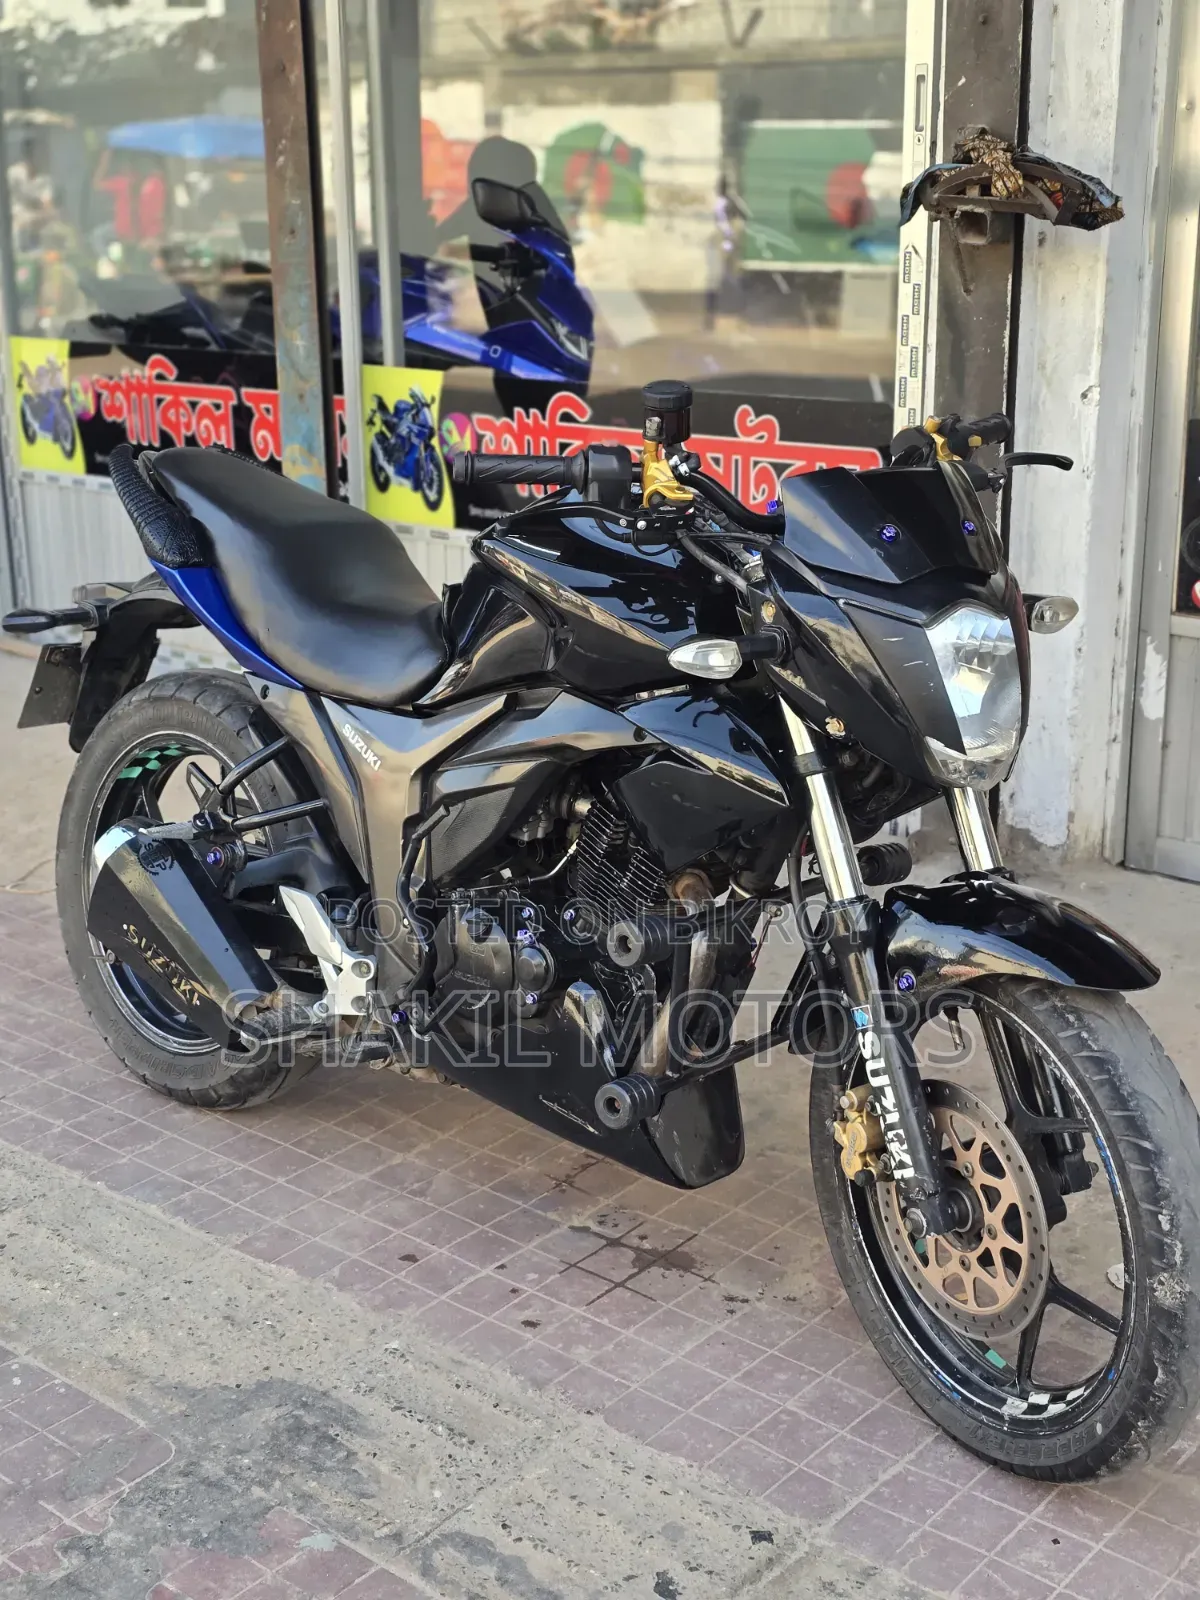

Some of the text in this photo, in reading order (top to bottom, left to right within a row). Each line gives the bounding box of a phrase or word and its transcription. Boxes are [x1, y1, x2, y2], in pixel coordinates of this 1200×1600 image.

[94, 354, 236, 449] শাকিল
[342, 723, 381, 771] SUZUKI
[857, 1031, 915, 1180] SUZUKI
